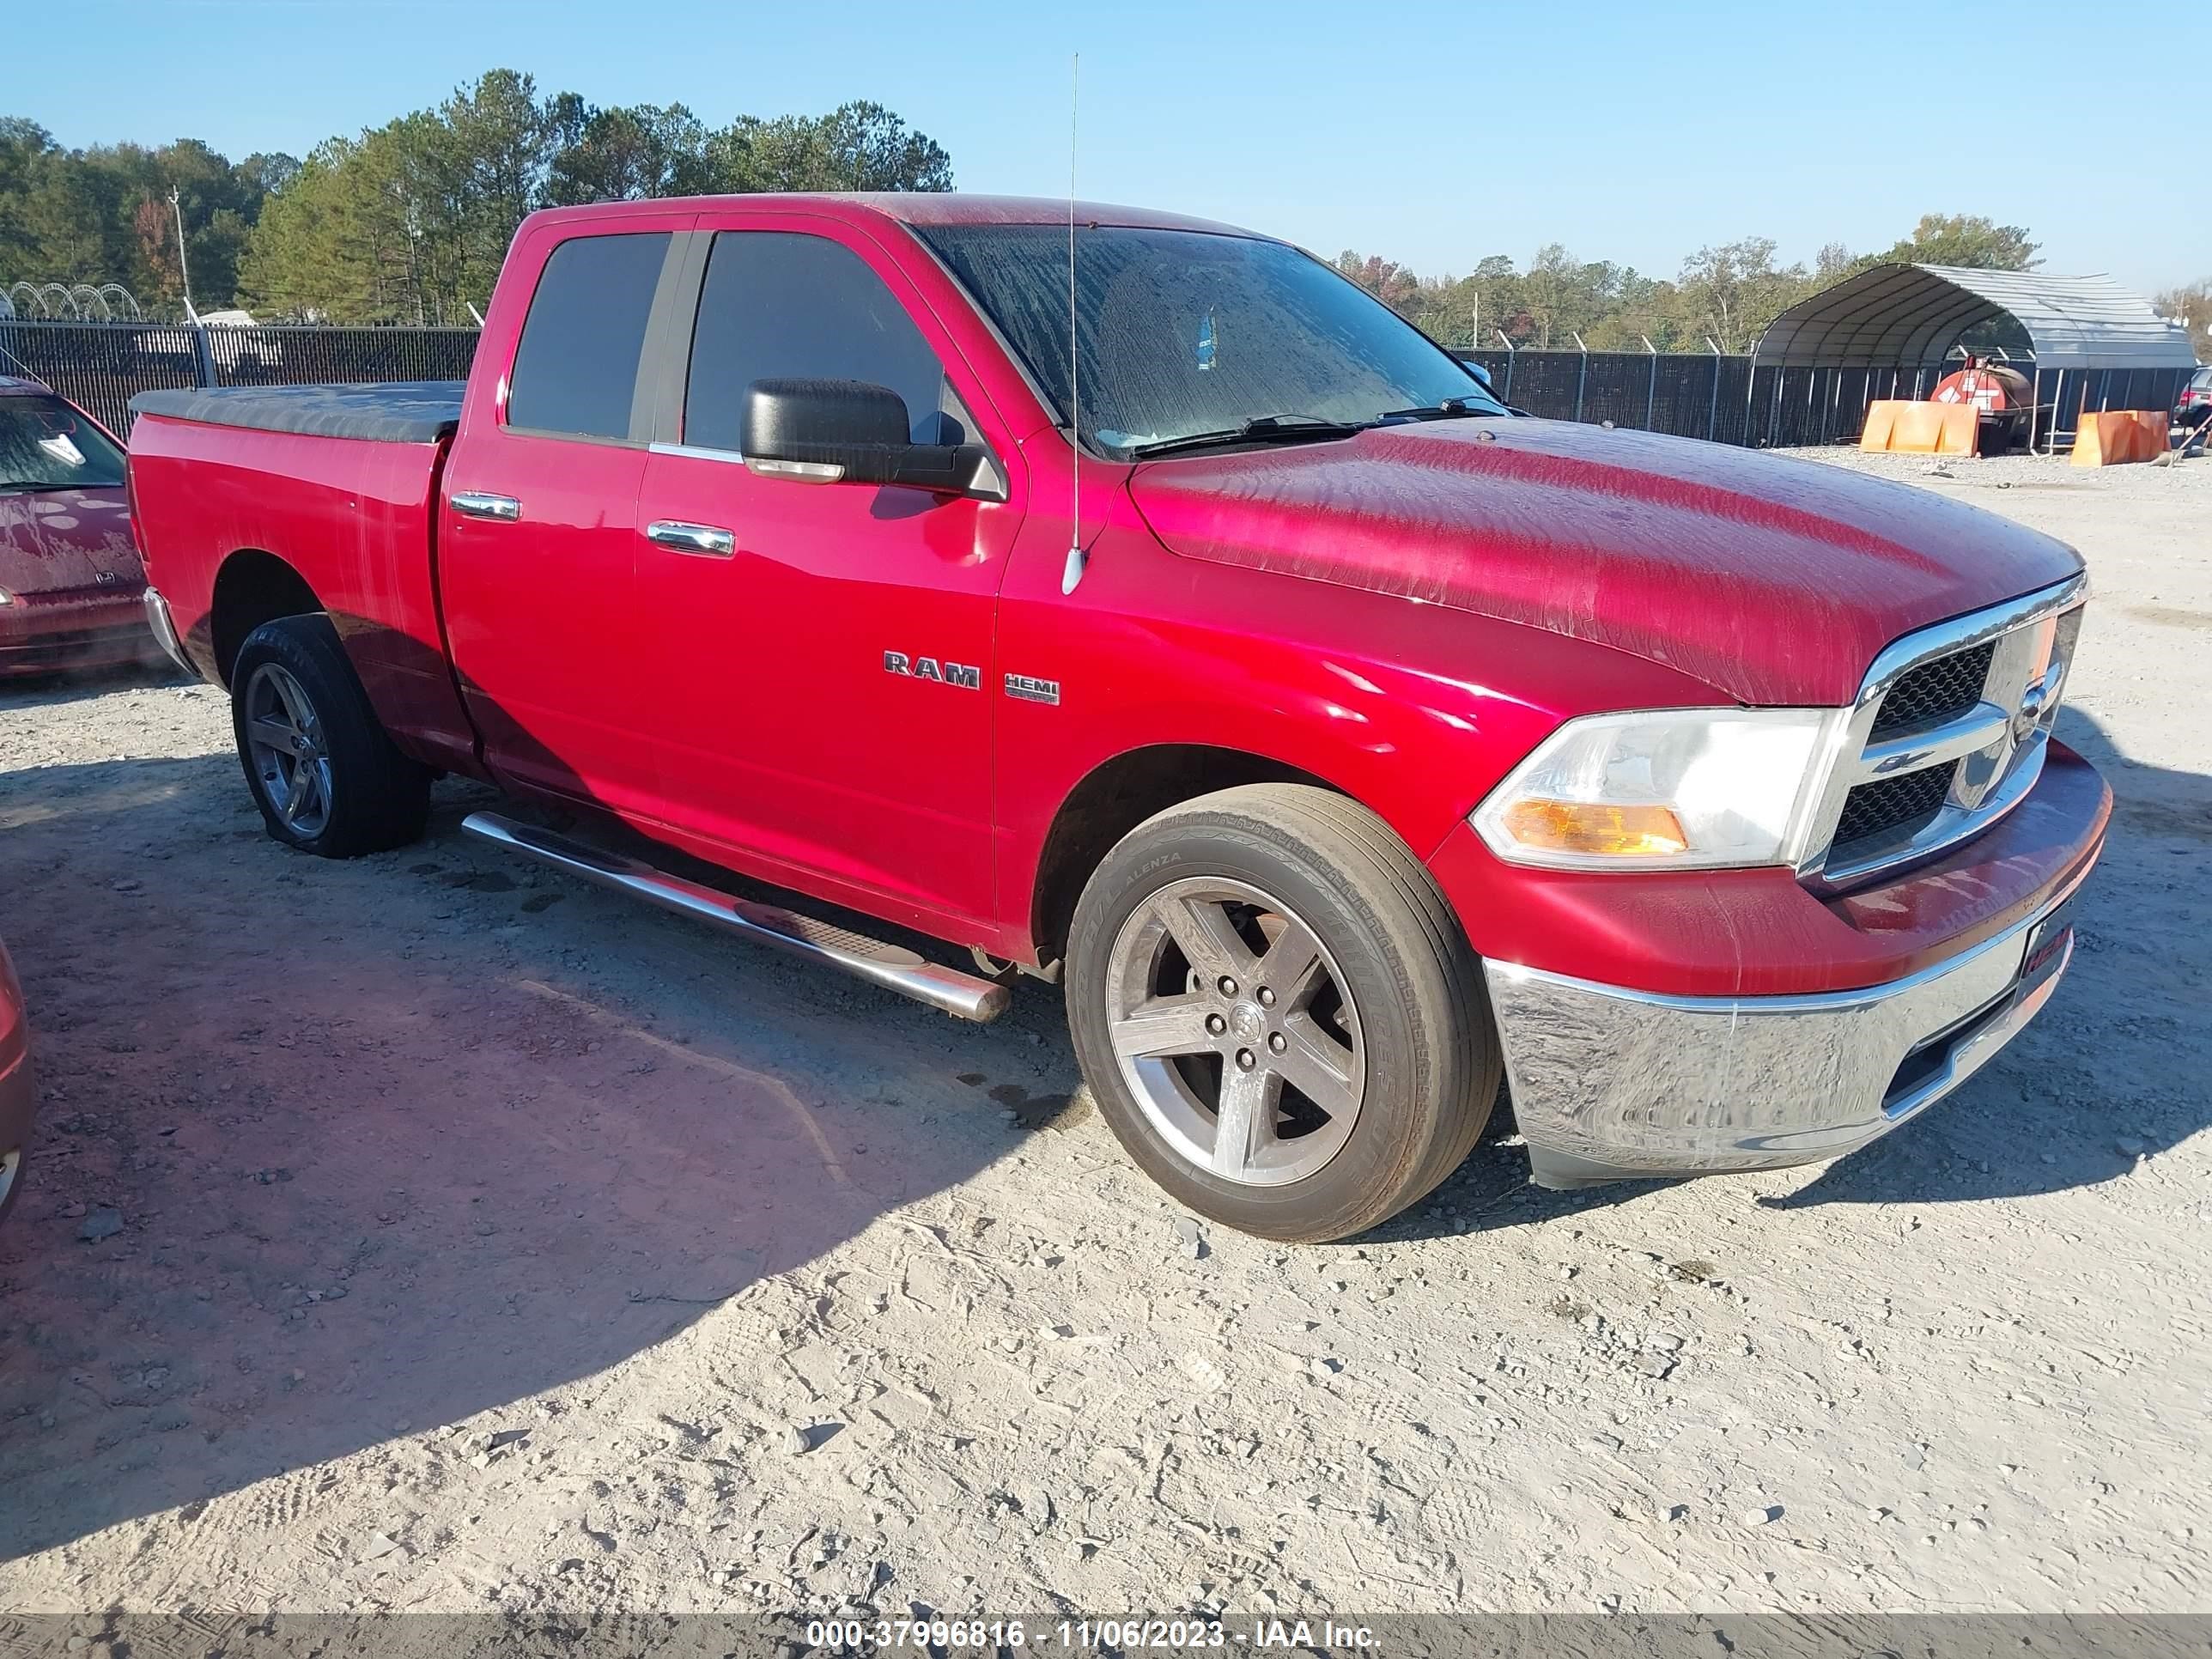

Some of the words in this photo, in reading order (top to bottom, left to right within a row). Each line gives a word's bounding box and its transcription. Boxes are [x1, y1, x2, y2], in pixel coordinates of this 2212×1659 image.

[884, 650, 981, 691] RAM
[1005, 674, 1059, 695] HEMI
[1125, 851, 1182, 886] ALENZA
